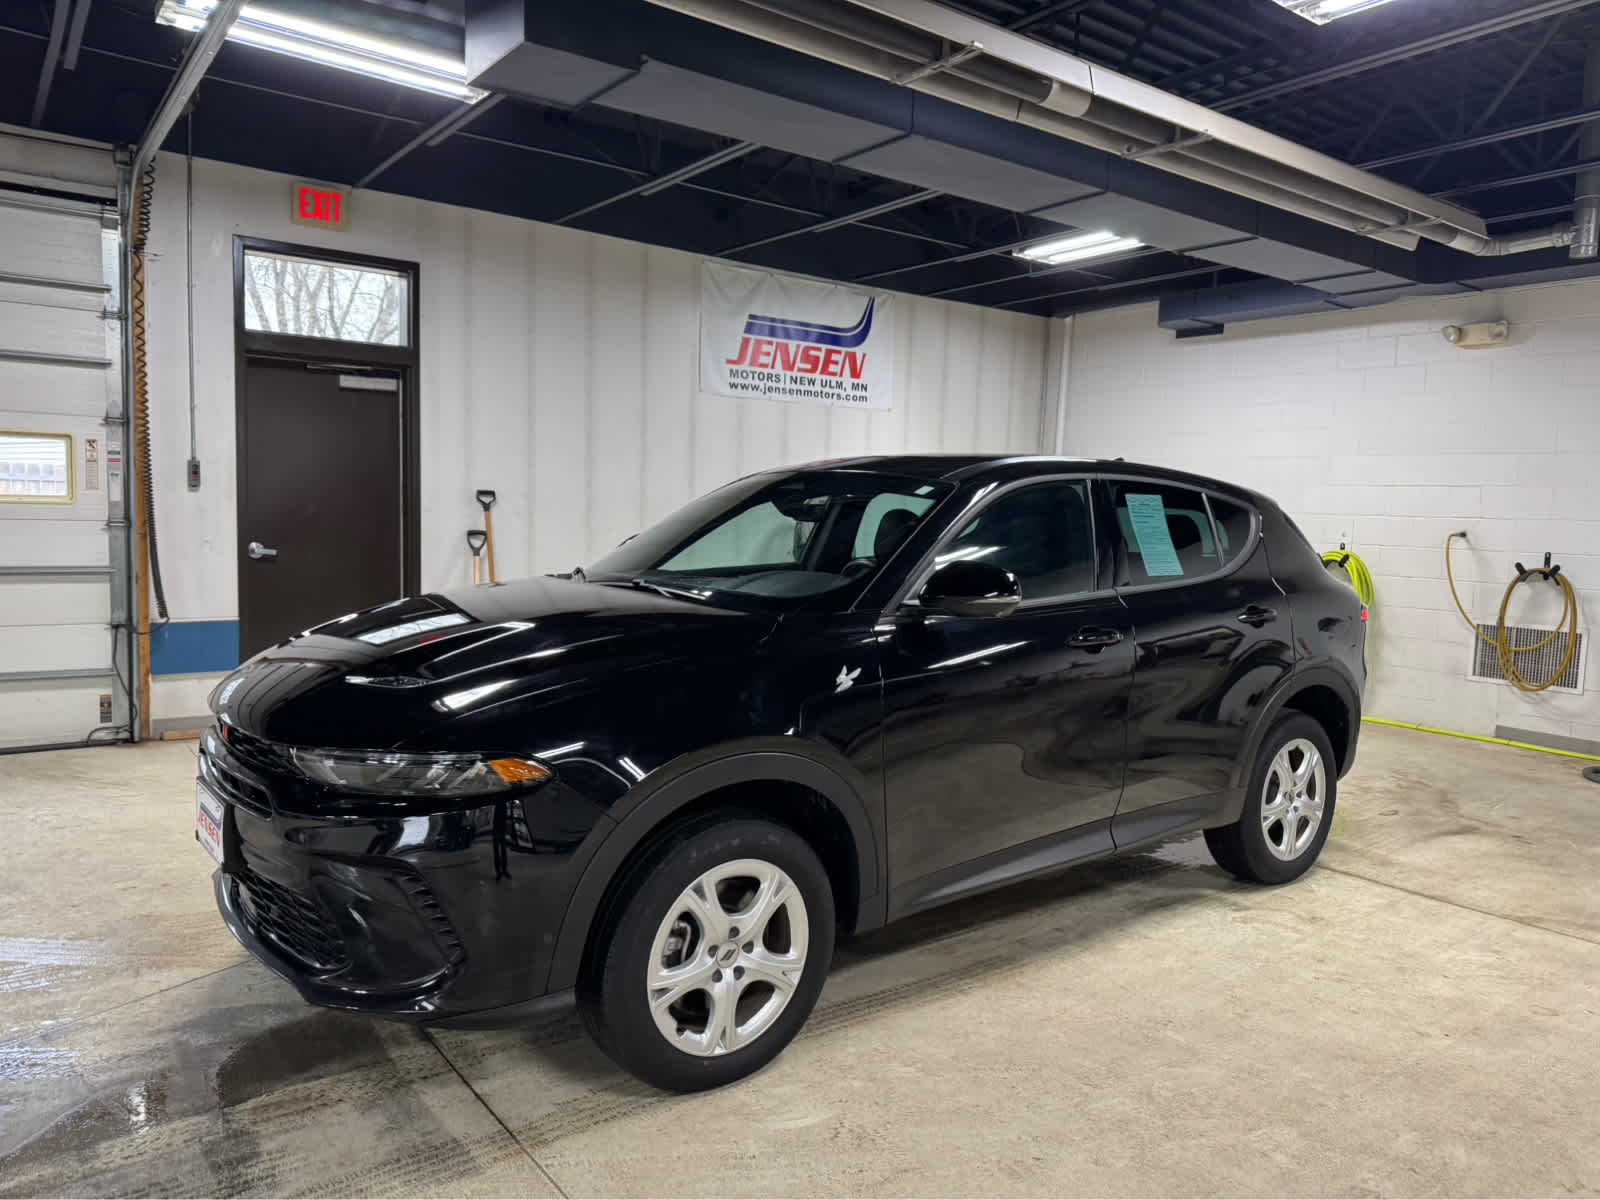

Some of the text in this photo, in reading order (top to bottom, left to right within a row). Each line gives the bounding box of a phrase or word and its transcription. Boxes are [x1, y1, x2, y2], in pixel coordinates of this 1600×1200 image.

[299, 187, 343, 223] EXIT
[725, 336, 867, 380] JENSEN
[729, 368, 868, 393] MOTORS NEW ULM, MN
[729, 381, 868, 403] www.jensenmotors.com
